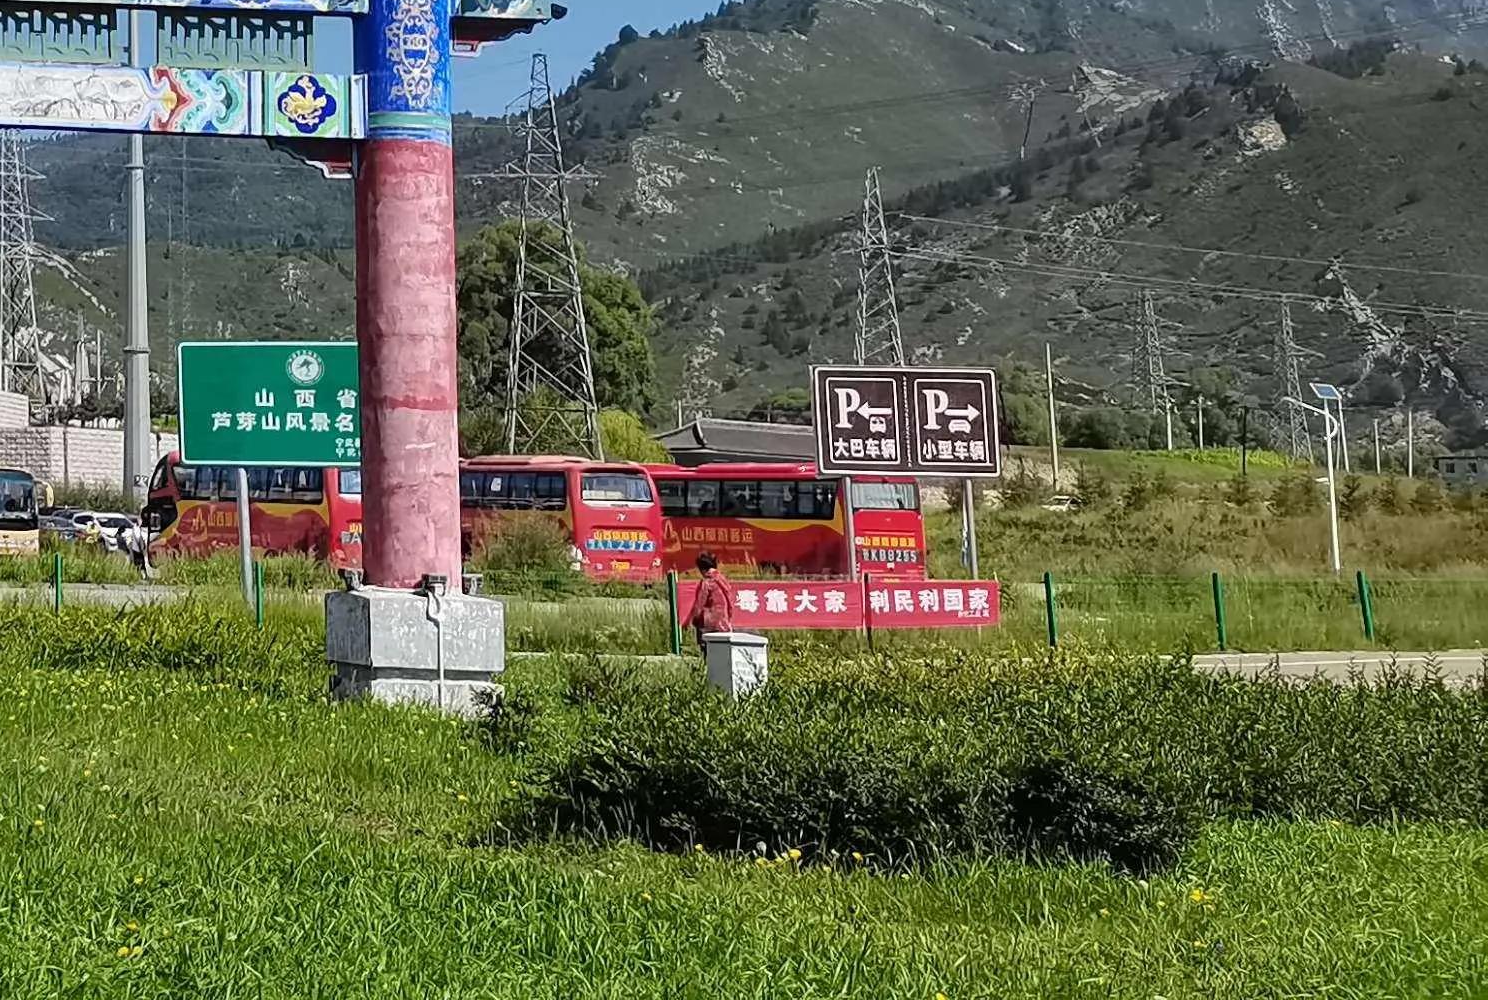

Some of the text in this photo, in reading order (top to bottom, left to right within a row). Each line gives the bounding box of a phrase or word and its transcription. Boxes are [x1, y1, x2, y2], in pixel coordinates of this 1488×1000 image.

[254, 388, 358, 410] 山西省
[834, 388, 861, 429] P
[922, 389, 949, 430] P
[211, 412, 355, 432] 芦芽山风景名
[834, 437, 896, 460] 大巴车辆
[923, 439, 985, 461] 小型车辆
[869, 588, 991, 613] 利民利国家
